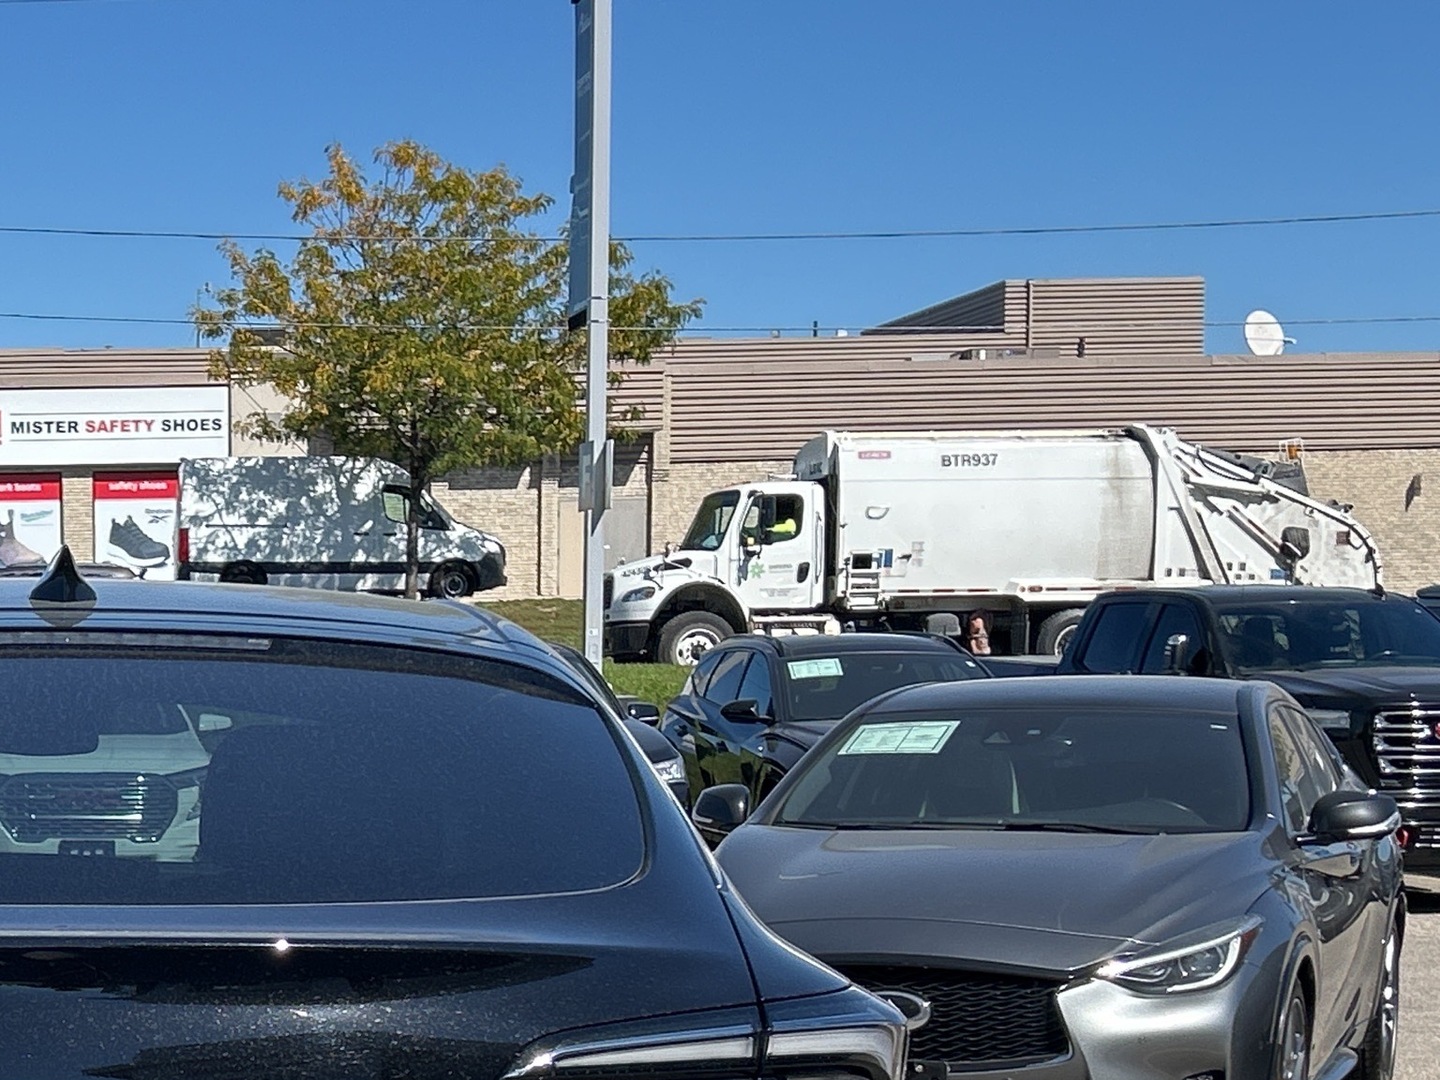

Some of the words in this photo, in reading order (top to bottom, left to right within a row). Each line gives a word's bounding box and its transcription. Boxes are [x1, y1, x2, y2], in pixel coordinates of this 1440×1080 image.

[11, 420, 79, 434] MISTER
[85, 419, 155, 433] SAFETY
[161, 418, 222, 432] SHOES
[941, 453, 998, 467] BTR937
